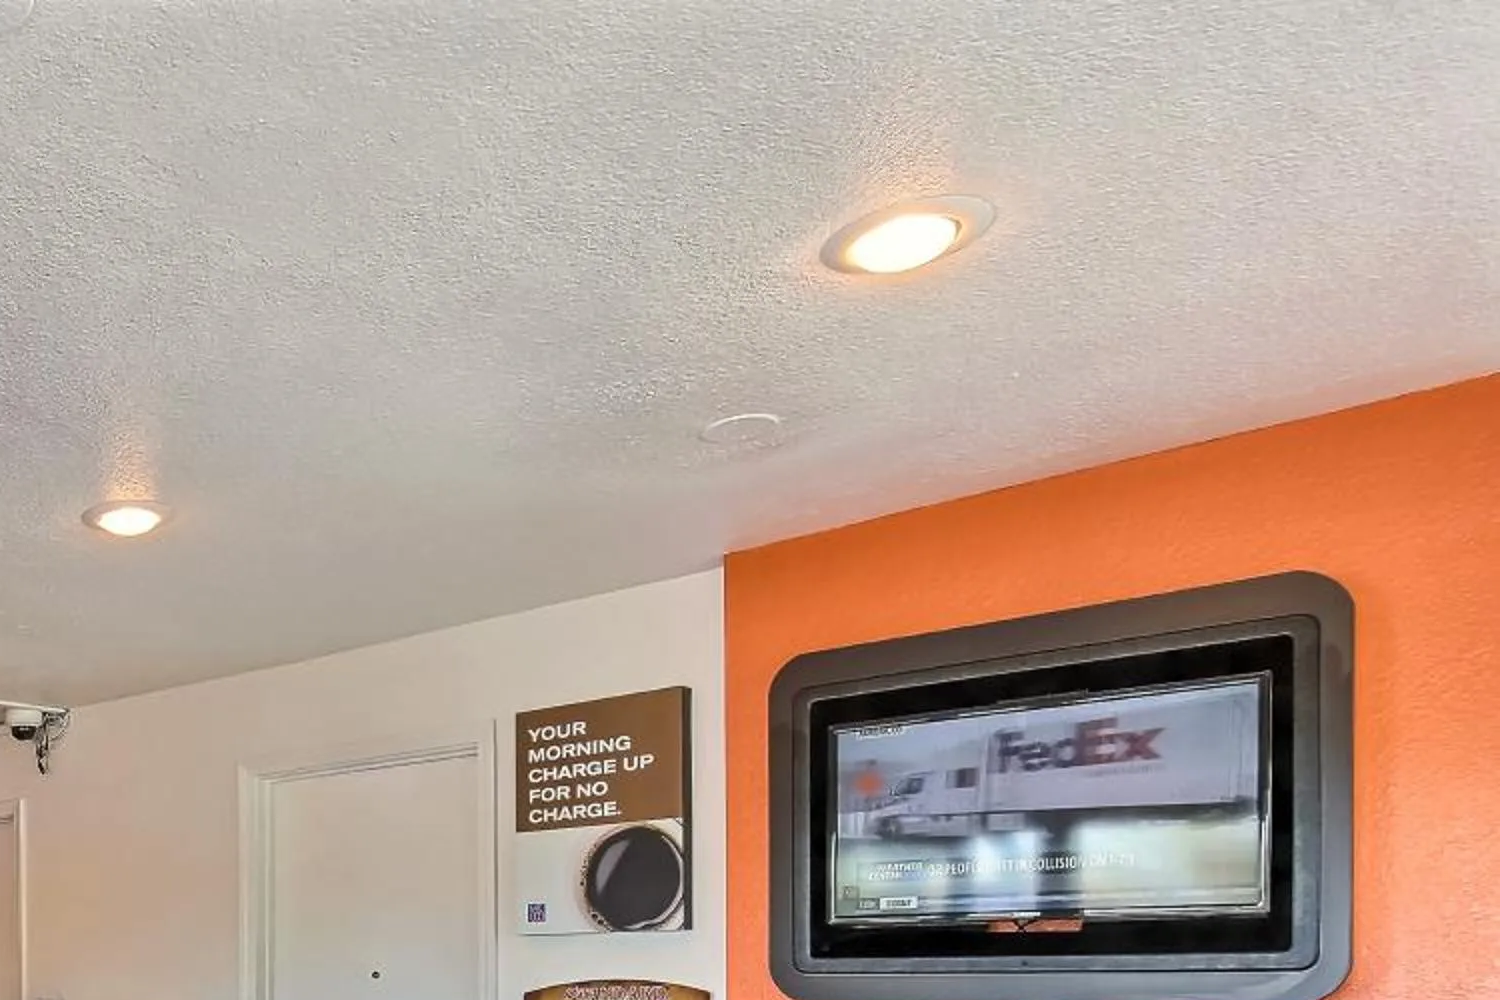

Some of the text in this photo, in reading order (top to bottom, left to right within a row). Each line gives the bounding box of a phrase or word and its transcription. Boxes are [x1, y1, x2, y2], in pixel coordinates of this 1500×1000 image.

[528, 721, 587, 743] YOUR
[528, 735, 632, 764] MORNING
[995, 717, 1167, 774] FedEx
[528, 754, 655, 784] CHARGE UP
[529, 781, 609, 804] FOR NO
[528, 801, 622, 824] CHARGE.
